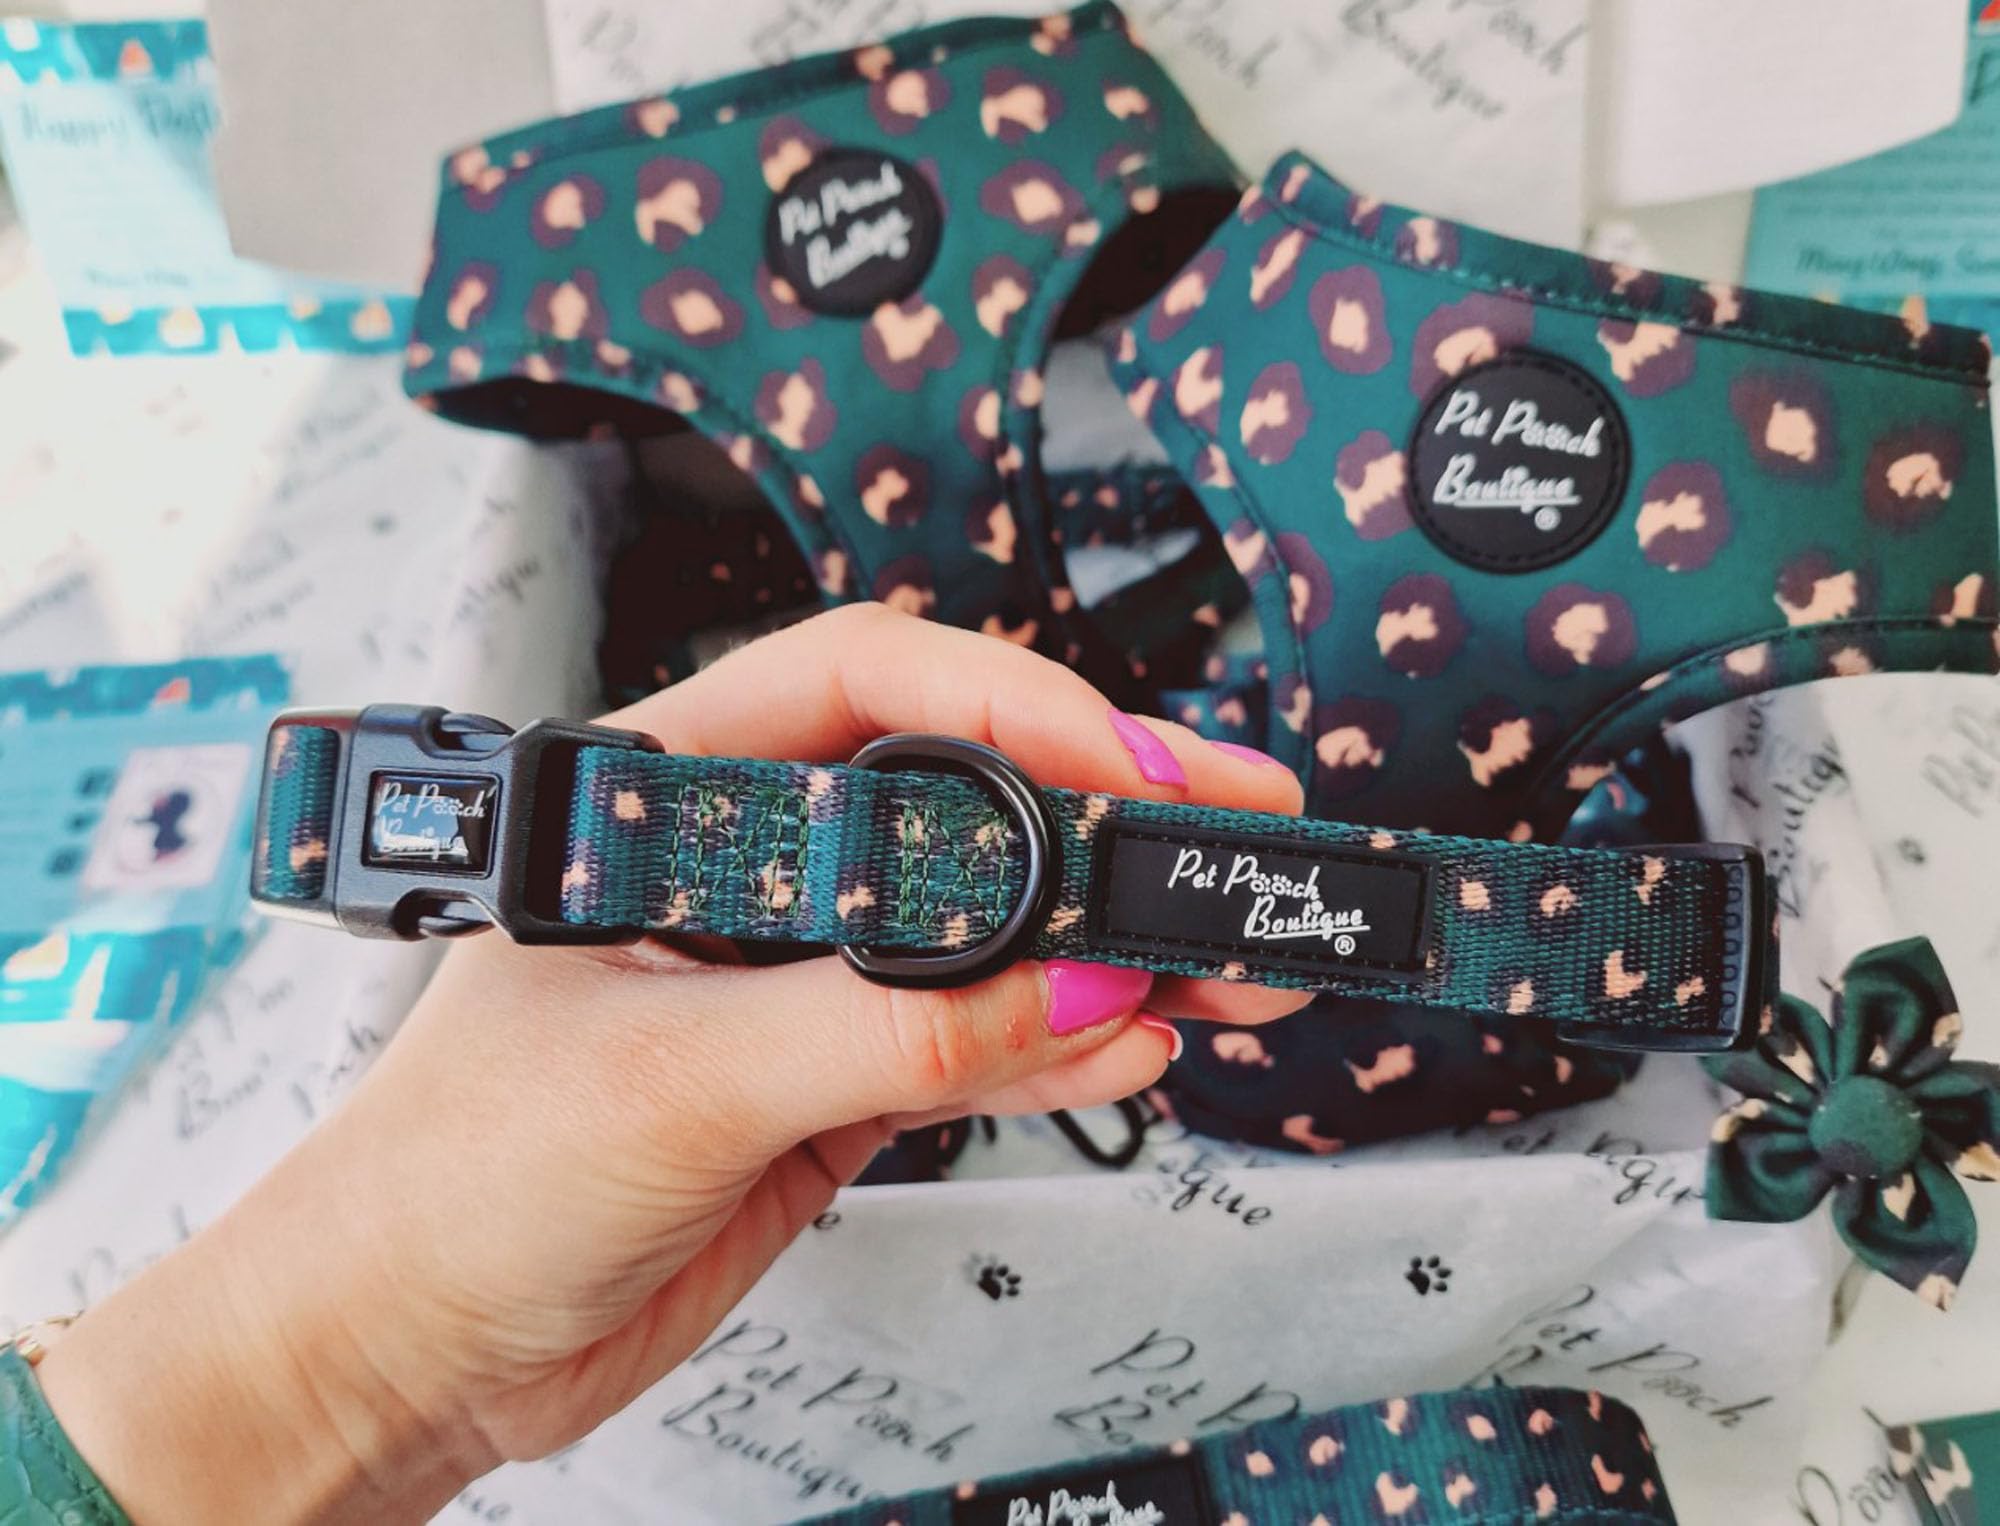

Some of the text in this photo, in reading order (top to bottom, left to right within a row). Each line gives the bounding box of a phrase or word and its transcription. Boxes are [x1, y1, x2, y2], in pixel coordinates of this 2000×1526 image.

[1434, 389, 1494, 436] Pet
[1432, 453, 1582, 514] Boutique
[374, 781, 487, 818] Pet Pooch
[1167, 848, 1320, 900] Pet Pooch
[1243, 894, 1371, 941] Boutique
[690, 1318, 805, 1393] Pet
[1090, 1328, 1206, 1408] Pet
[660, 1383, 862, 1500] Boutiqu
